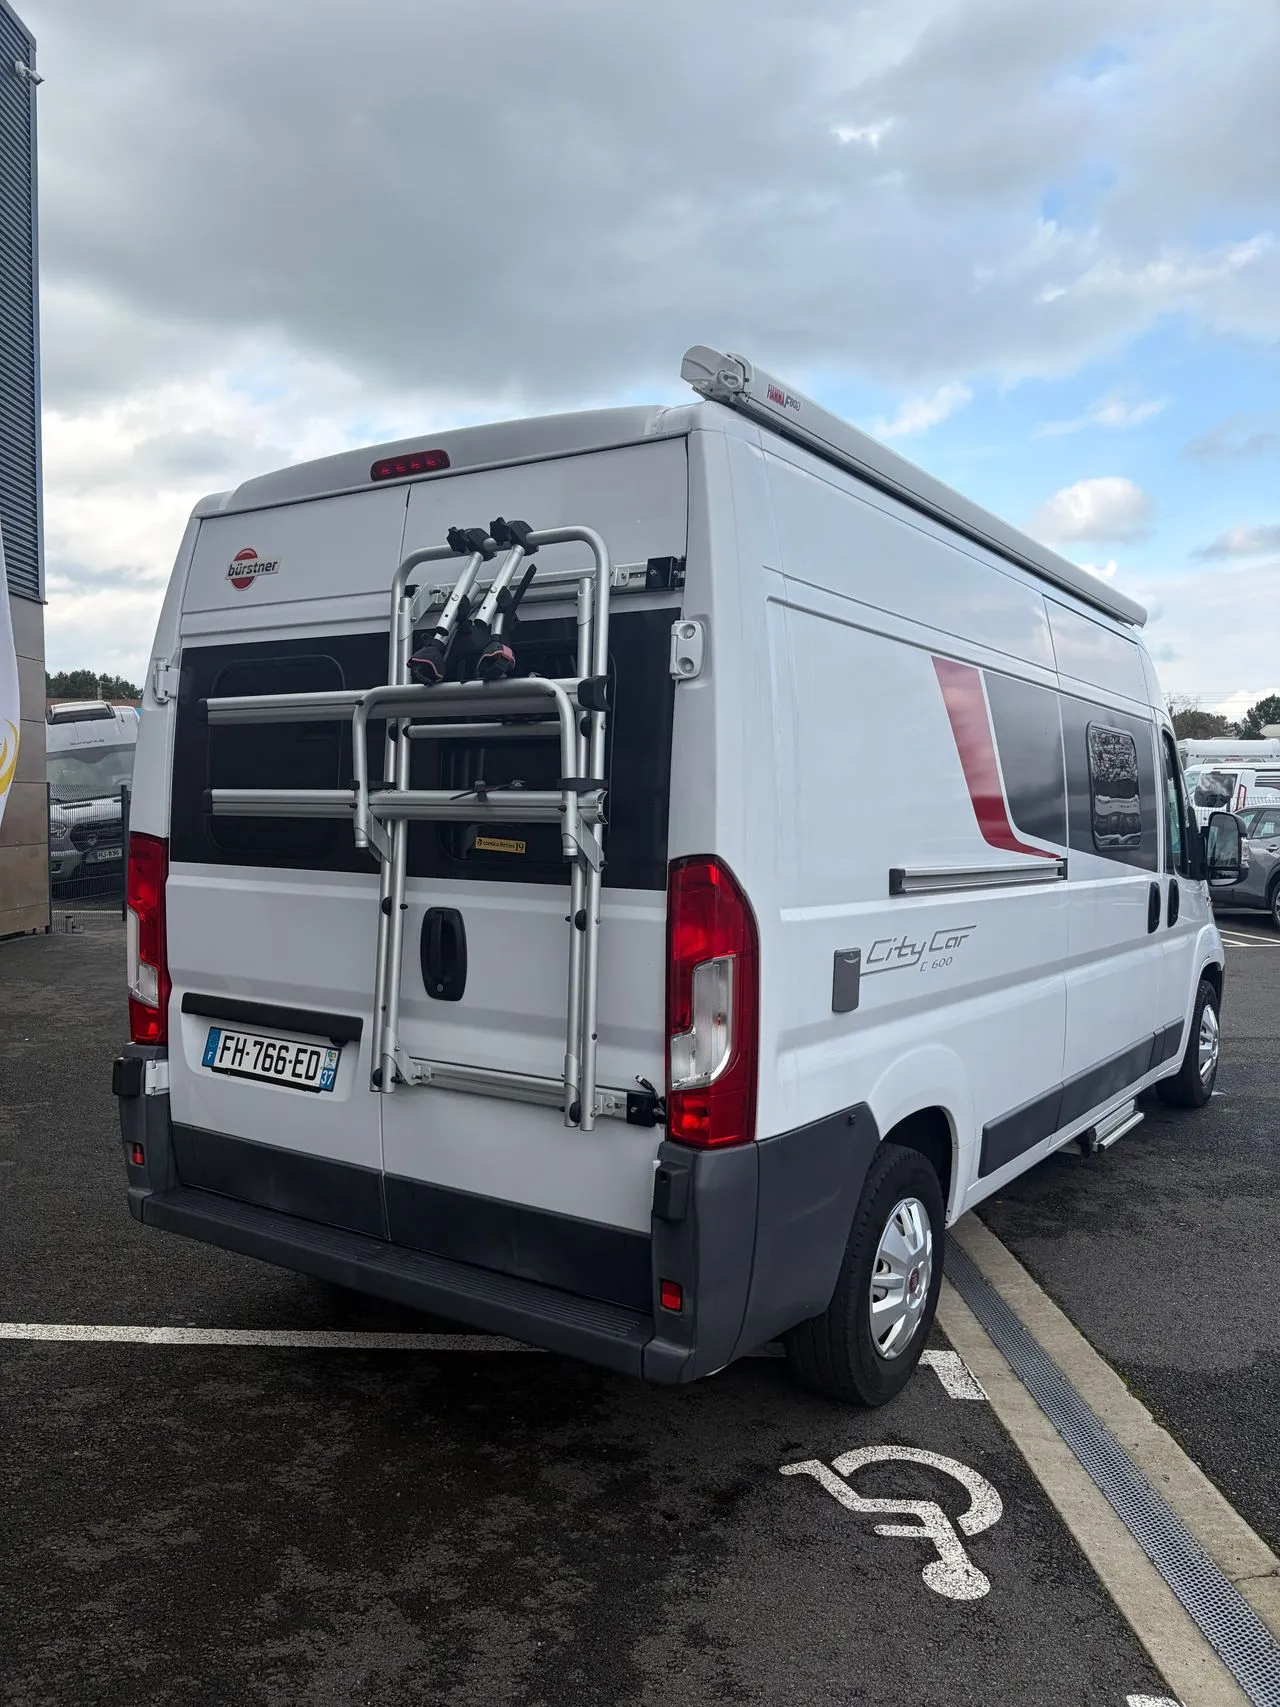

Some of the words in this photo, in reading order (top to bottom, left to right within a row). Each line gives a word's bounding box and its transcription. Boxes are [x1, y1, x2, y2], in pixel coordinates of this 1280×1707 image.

[227, 561, 278, 577] bürstner
[515, 842, 524, 851] 19
[861, 935, 927, 976] City
[929, 925, 977, 952] Car
[931, 956, 953, 969] 600
[207, 1051, 214, 1060] F
[219, 1034, 321, 1081] FH-766-ED
[321, 1069, 334, 1085] 37
